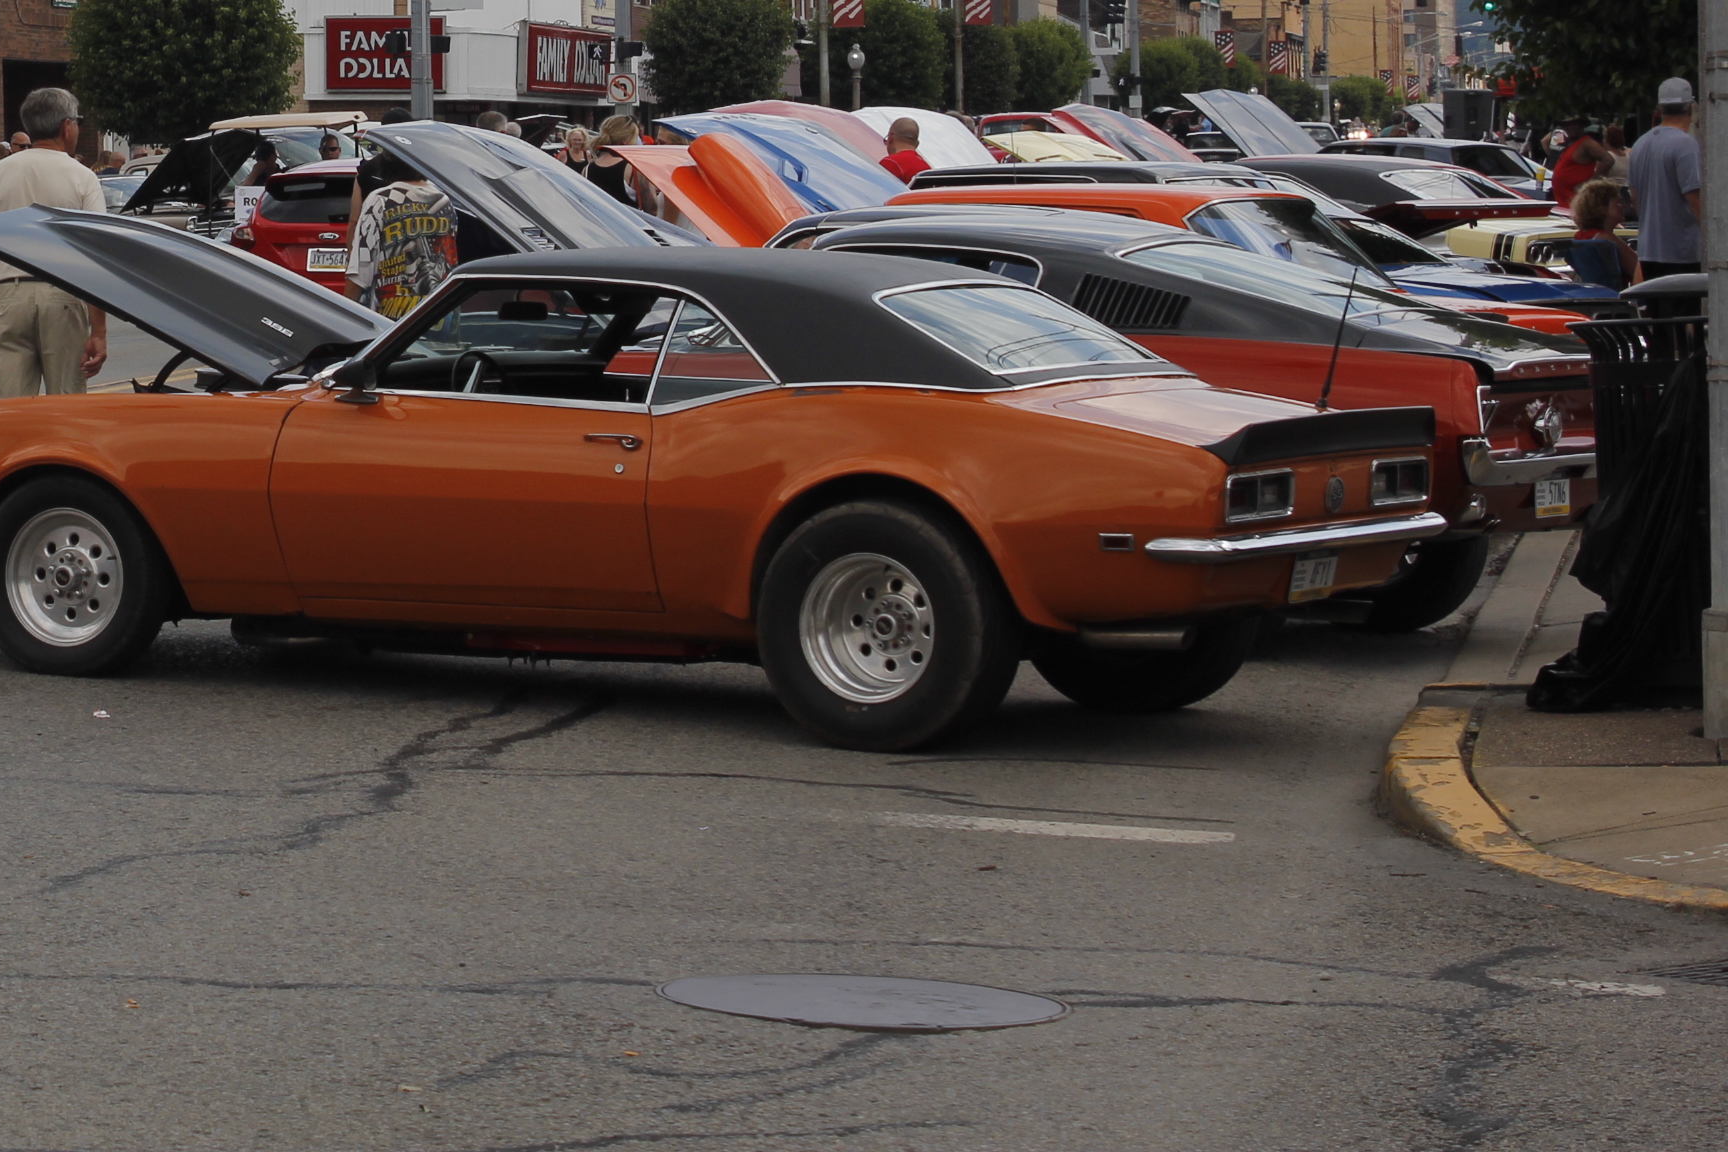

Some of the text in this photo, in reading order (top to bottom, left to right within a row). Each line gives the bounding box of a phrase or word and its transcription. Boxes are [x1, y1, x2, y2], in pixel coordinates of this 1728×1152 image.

[339, 57, 411, 79] DOLLA
[536, 35, 571, 83] FAMILY
[384, 202, 429, 221] RICKY
[383, 216, 450, 246] RUDD
[378, 251, 407, 270] United
[381, 263, 407, 278] States
[1548, 481, 1567, 505] 5TN6
